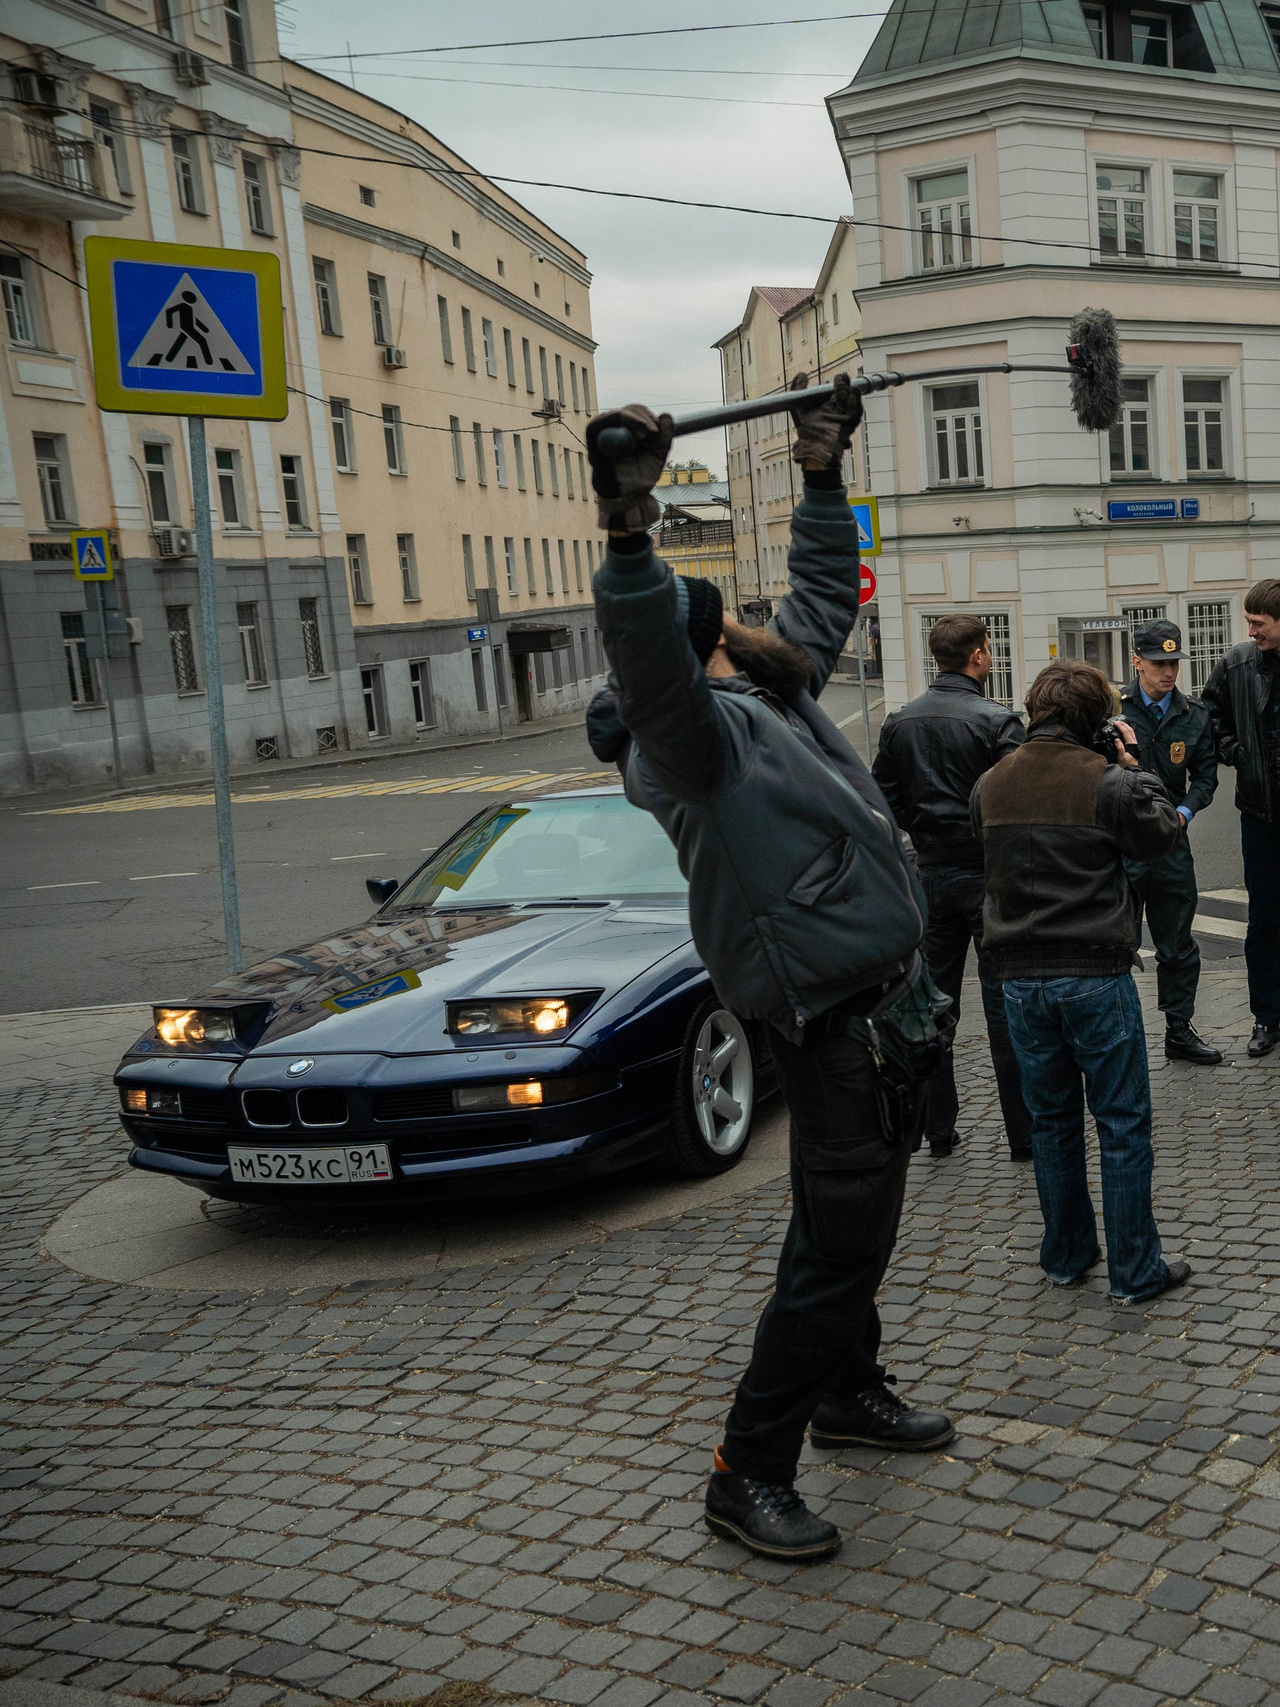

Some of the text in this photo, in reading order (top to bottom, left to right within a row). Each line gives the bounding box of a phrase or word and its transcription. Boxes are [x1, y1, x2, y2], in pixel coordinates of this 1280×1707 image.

[1083, 621, 1127, 629] ТЕЛЕФОН
[238, 1149, 378, 1179] М523КС 91
[351, 1170, 373, 1179] RUS
